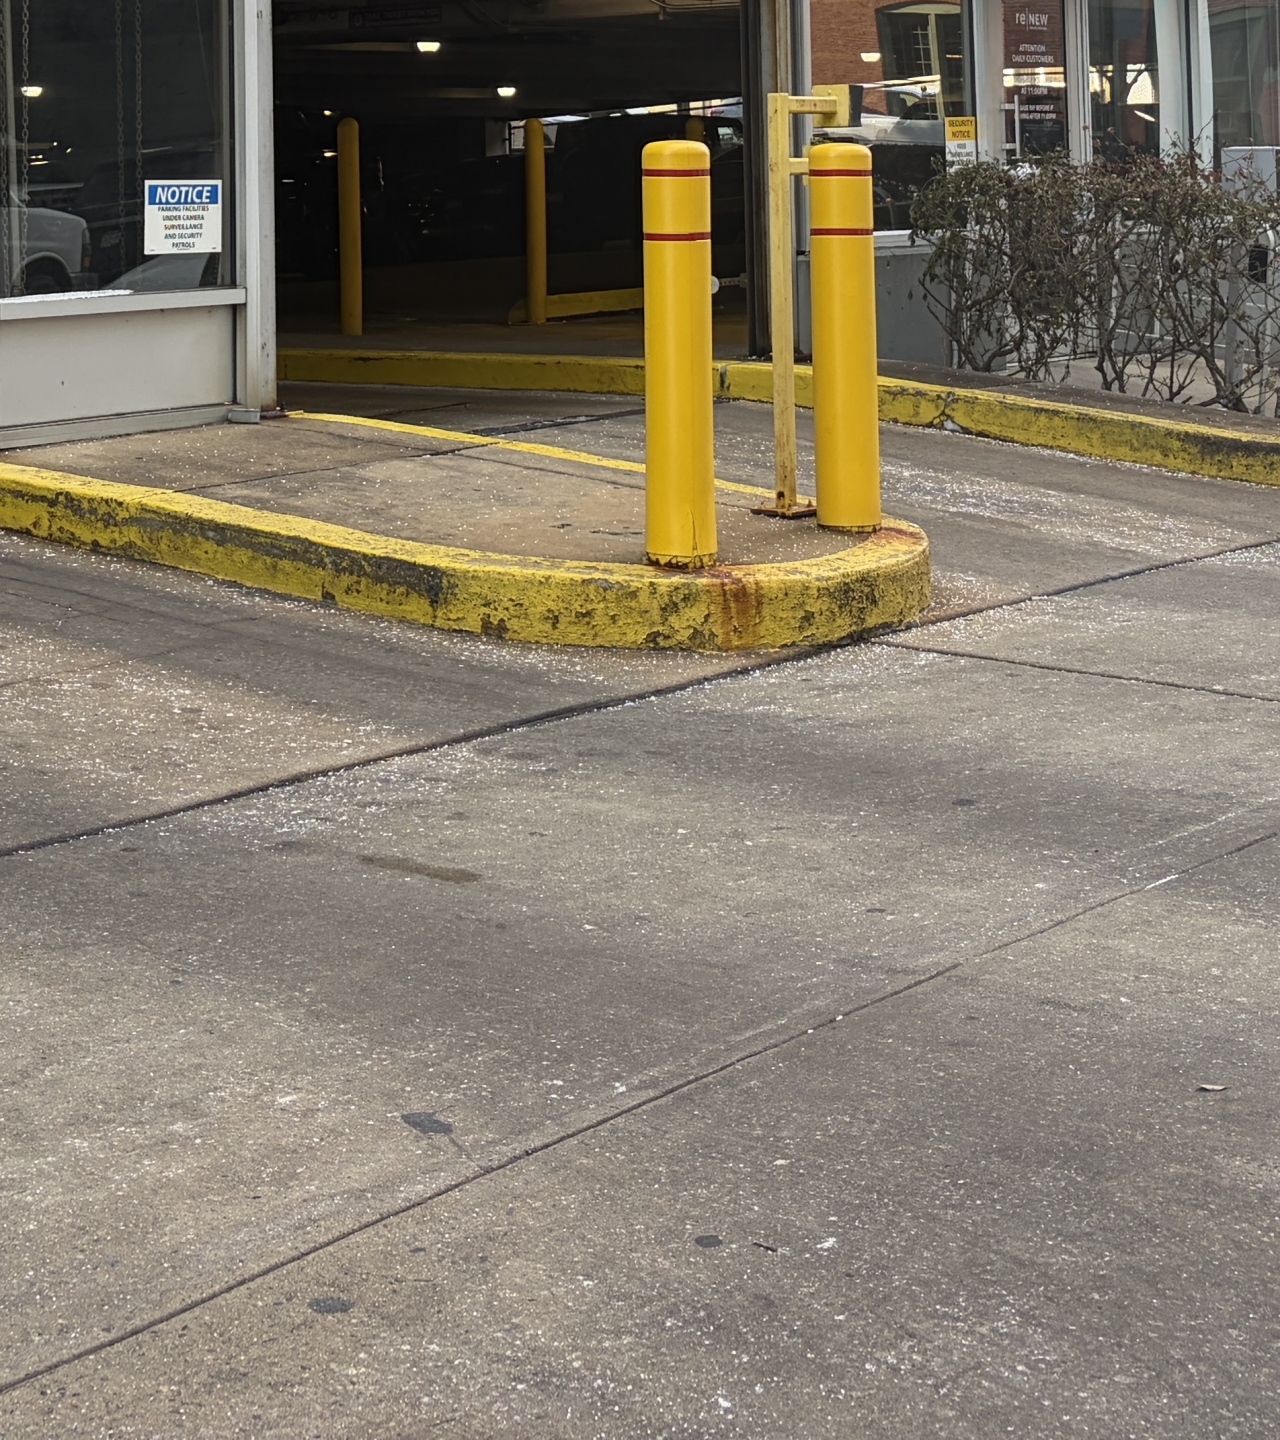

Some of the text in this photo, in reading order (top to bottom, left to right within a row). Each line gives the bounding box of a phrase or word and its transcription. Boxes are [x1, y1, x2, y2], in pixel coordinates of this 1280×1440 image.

[1019, 44, 1046, 52] ATTENTION
[1026, 55, 1054, 63] CUSTOMERS
[948, 119, 973, 127] SECURITY
[951, 130, 971, 138] NOTICE
[155, 186, 211, 203] NOTICE
